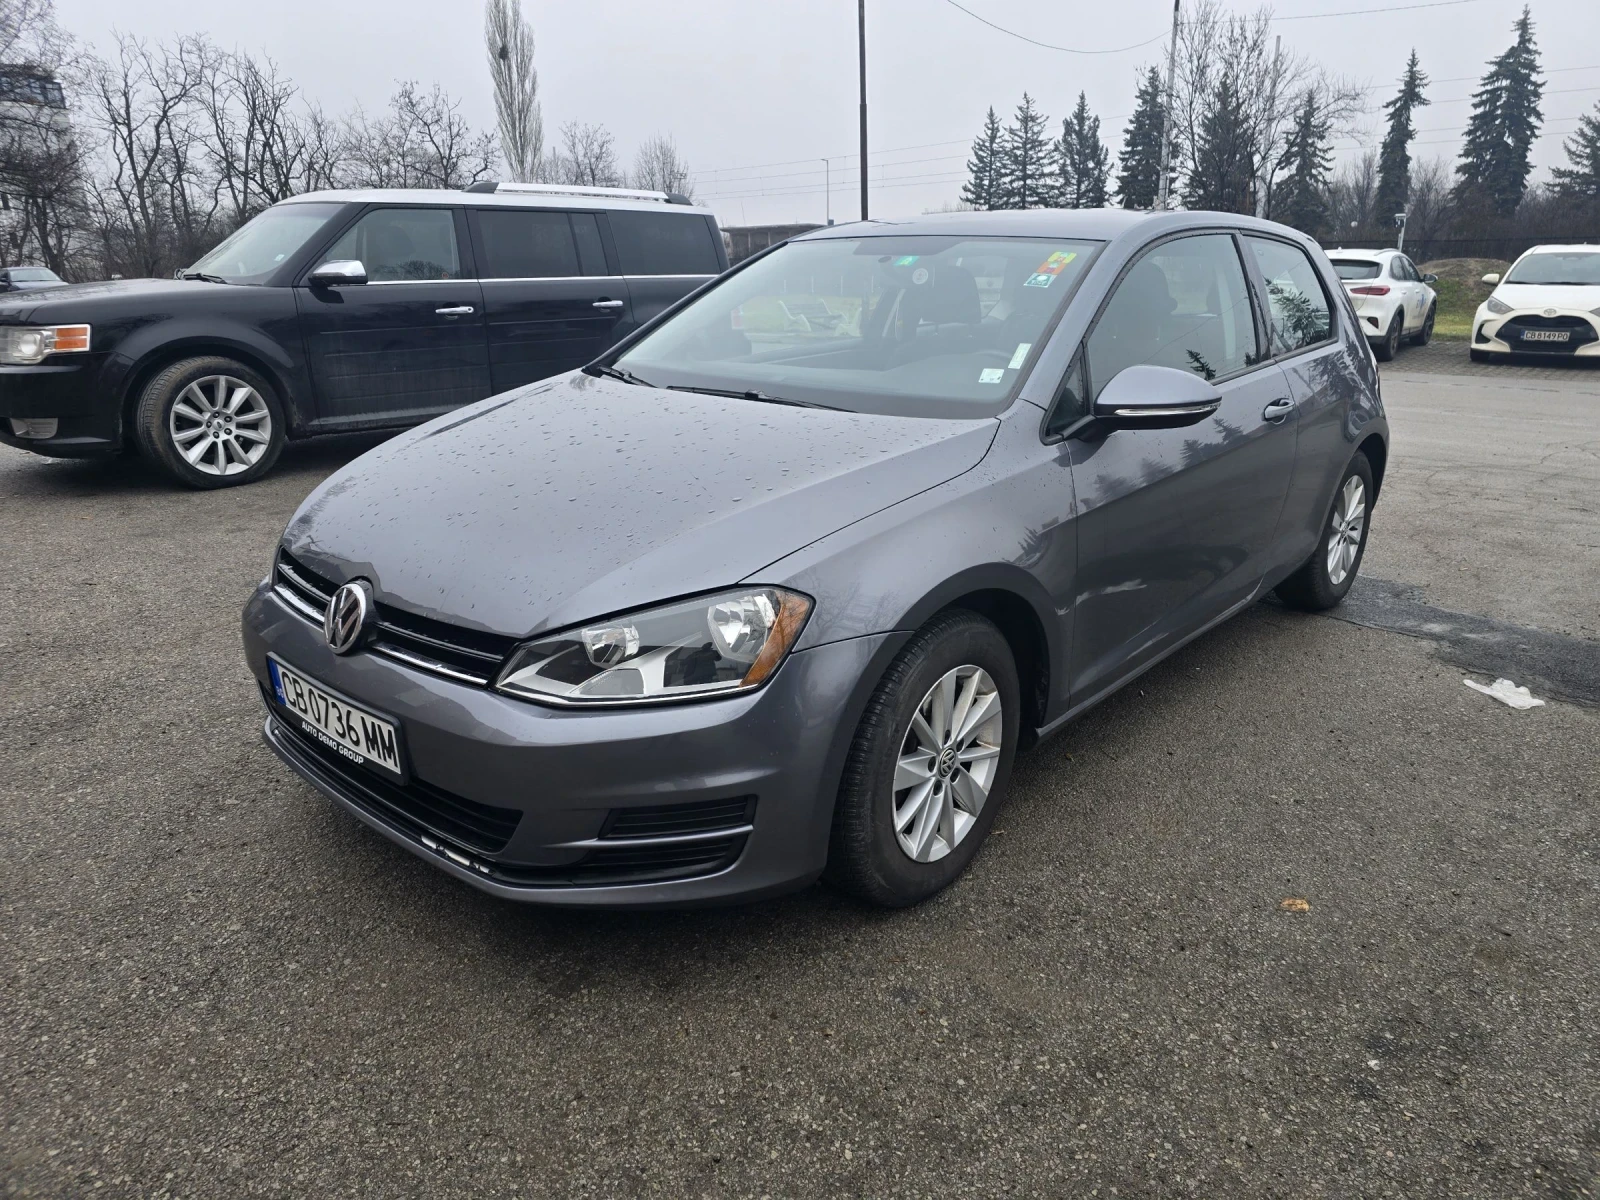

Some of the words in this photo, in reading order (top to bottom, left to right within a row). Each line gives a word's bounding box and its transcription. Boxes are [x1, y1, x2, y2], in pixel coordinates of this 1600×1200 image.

[301, 721, 317, 738] AUTO
[318, 731, 338, 750] DEMO
[338, 745, 364, 765] GROUP
